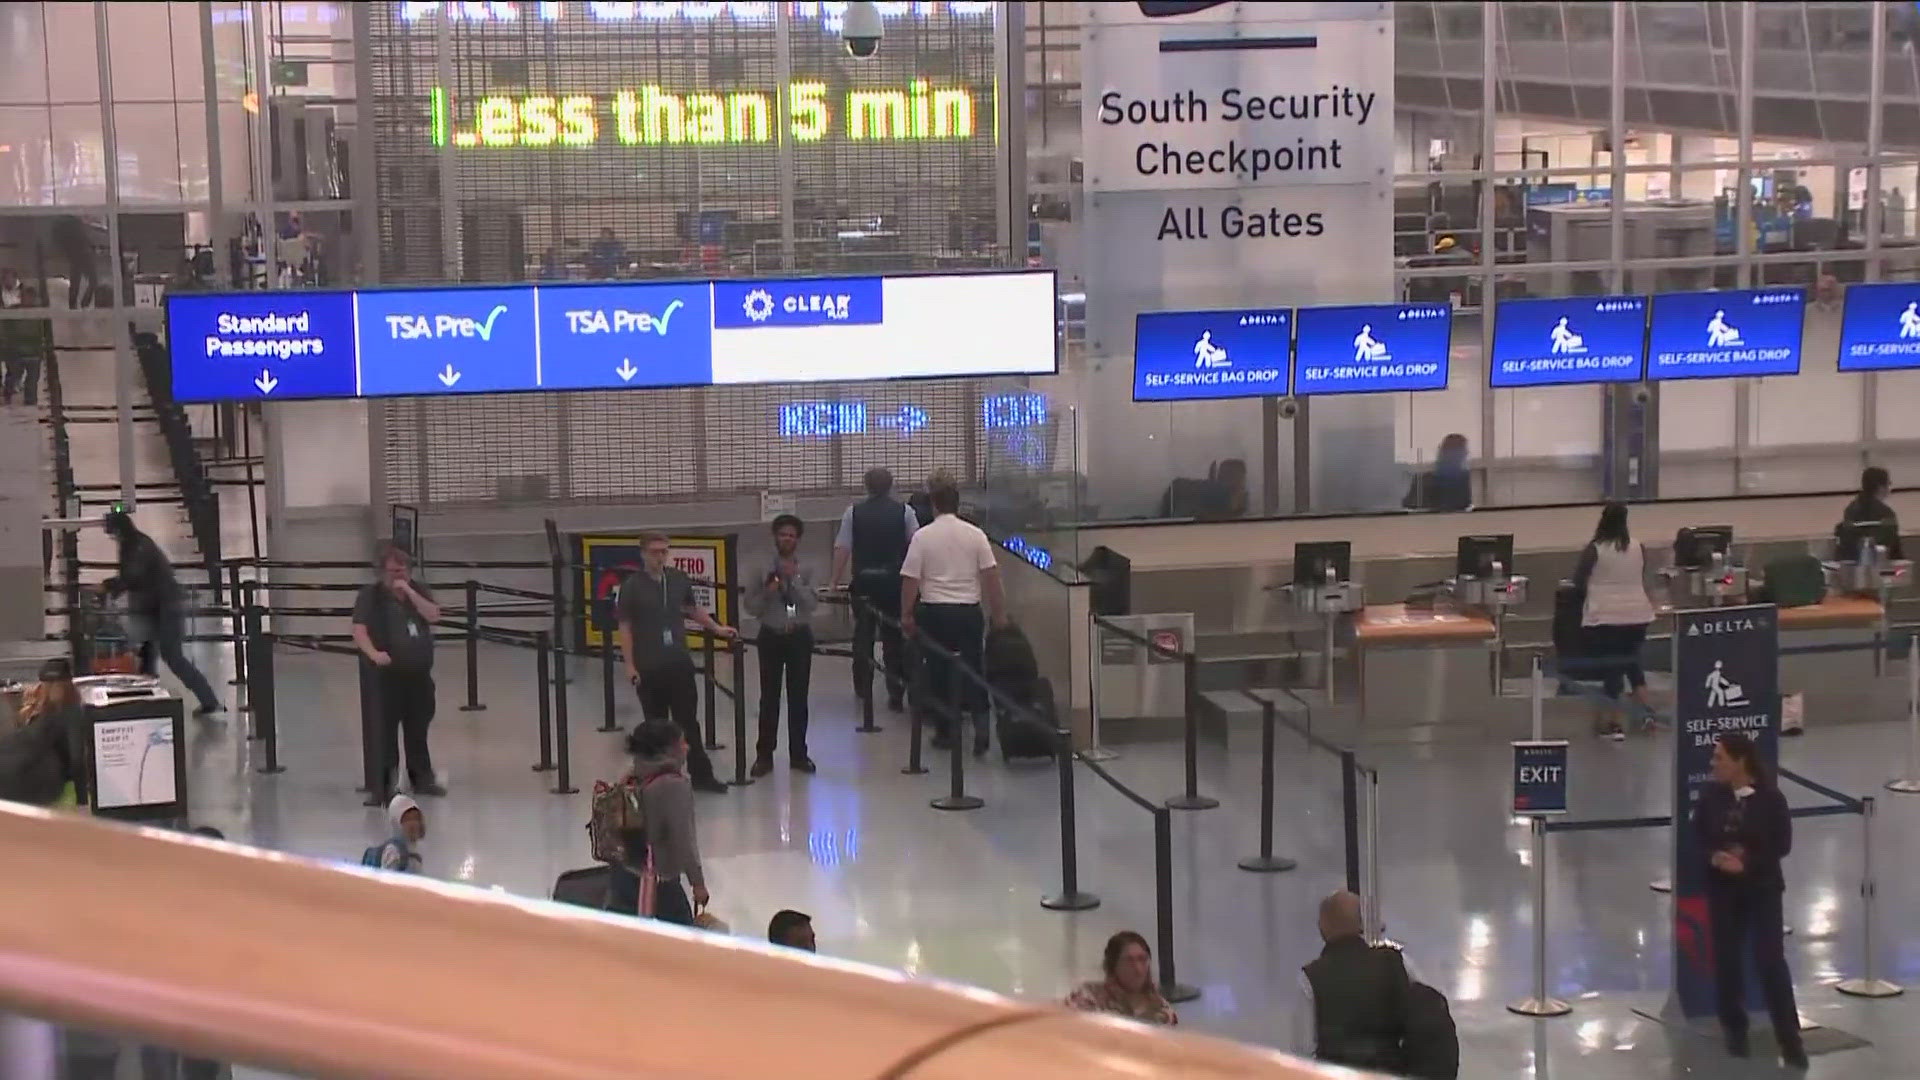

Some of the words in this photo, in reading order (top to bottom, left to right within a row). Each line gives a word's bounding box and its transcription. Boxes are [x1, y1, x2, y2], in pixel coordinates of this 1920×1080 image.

[612, 84, 772, 146] than
[789, 78, 833, 142] 5
[846, 75, 977, 140] min
[1101, 89, 1208, 124] South
[1221, 85, 1375, 126] Security
[1135, 138, 1342, 181] Checkpoint
[1157, 206, 1208, 241] All
[1220, 206, 1324, 239] Gates
[783, 294, 851, 313] CLEAR
[216, 310, 309, 335] Standard
[565, 311, 610, 334] TSA
[1249, 315, 1278, 326] DELTA
[1407, 309, 1438, 320] DELTA
[386, 315, 432, 339] TSA
[205, 336, 324, 360] Passengers
[1658, 351, 1731, 366] SELF-SERVICE
[1733, 350, 1757, 363] BAG
[1758, 348, 1791, 362] DROP
[1305, 365, 1379, 380] SELF-SERVICE
[1381, 364, 1404, 377] BAG
[1406, 362, 1438, 376] DROP
[1502, 357, 1575, 373] SELF-SERVICE
[1576, 356, 1600, 369] BAG
[1602, 355, 1634, 369] DROP
[1145, 372, 1219, 386] SELF-SERVICE
[1222, 371, 1245, 384] BAG
[1247, 369, 1279, 383] DROP
[1704, 618, 1754, 635] DELTA
[1686, 714, 1768, 733] SELF-SERVICE
[1520, 766, 1561, 783] EXIT
